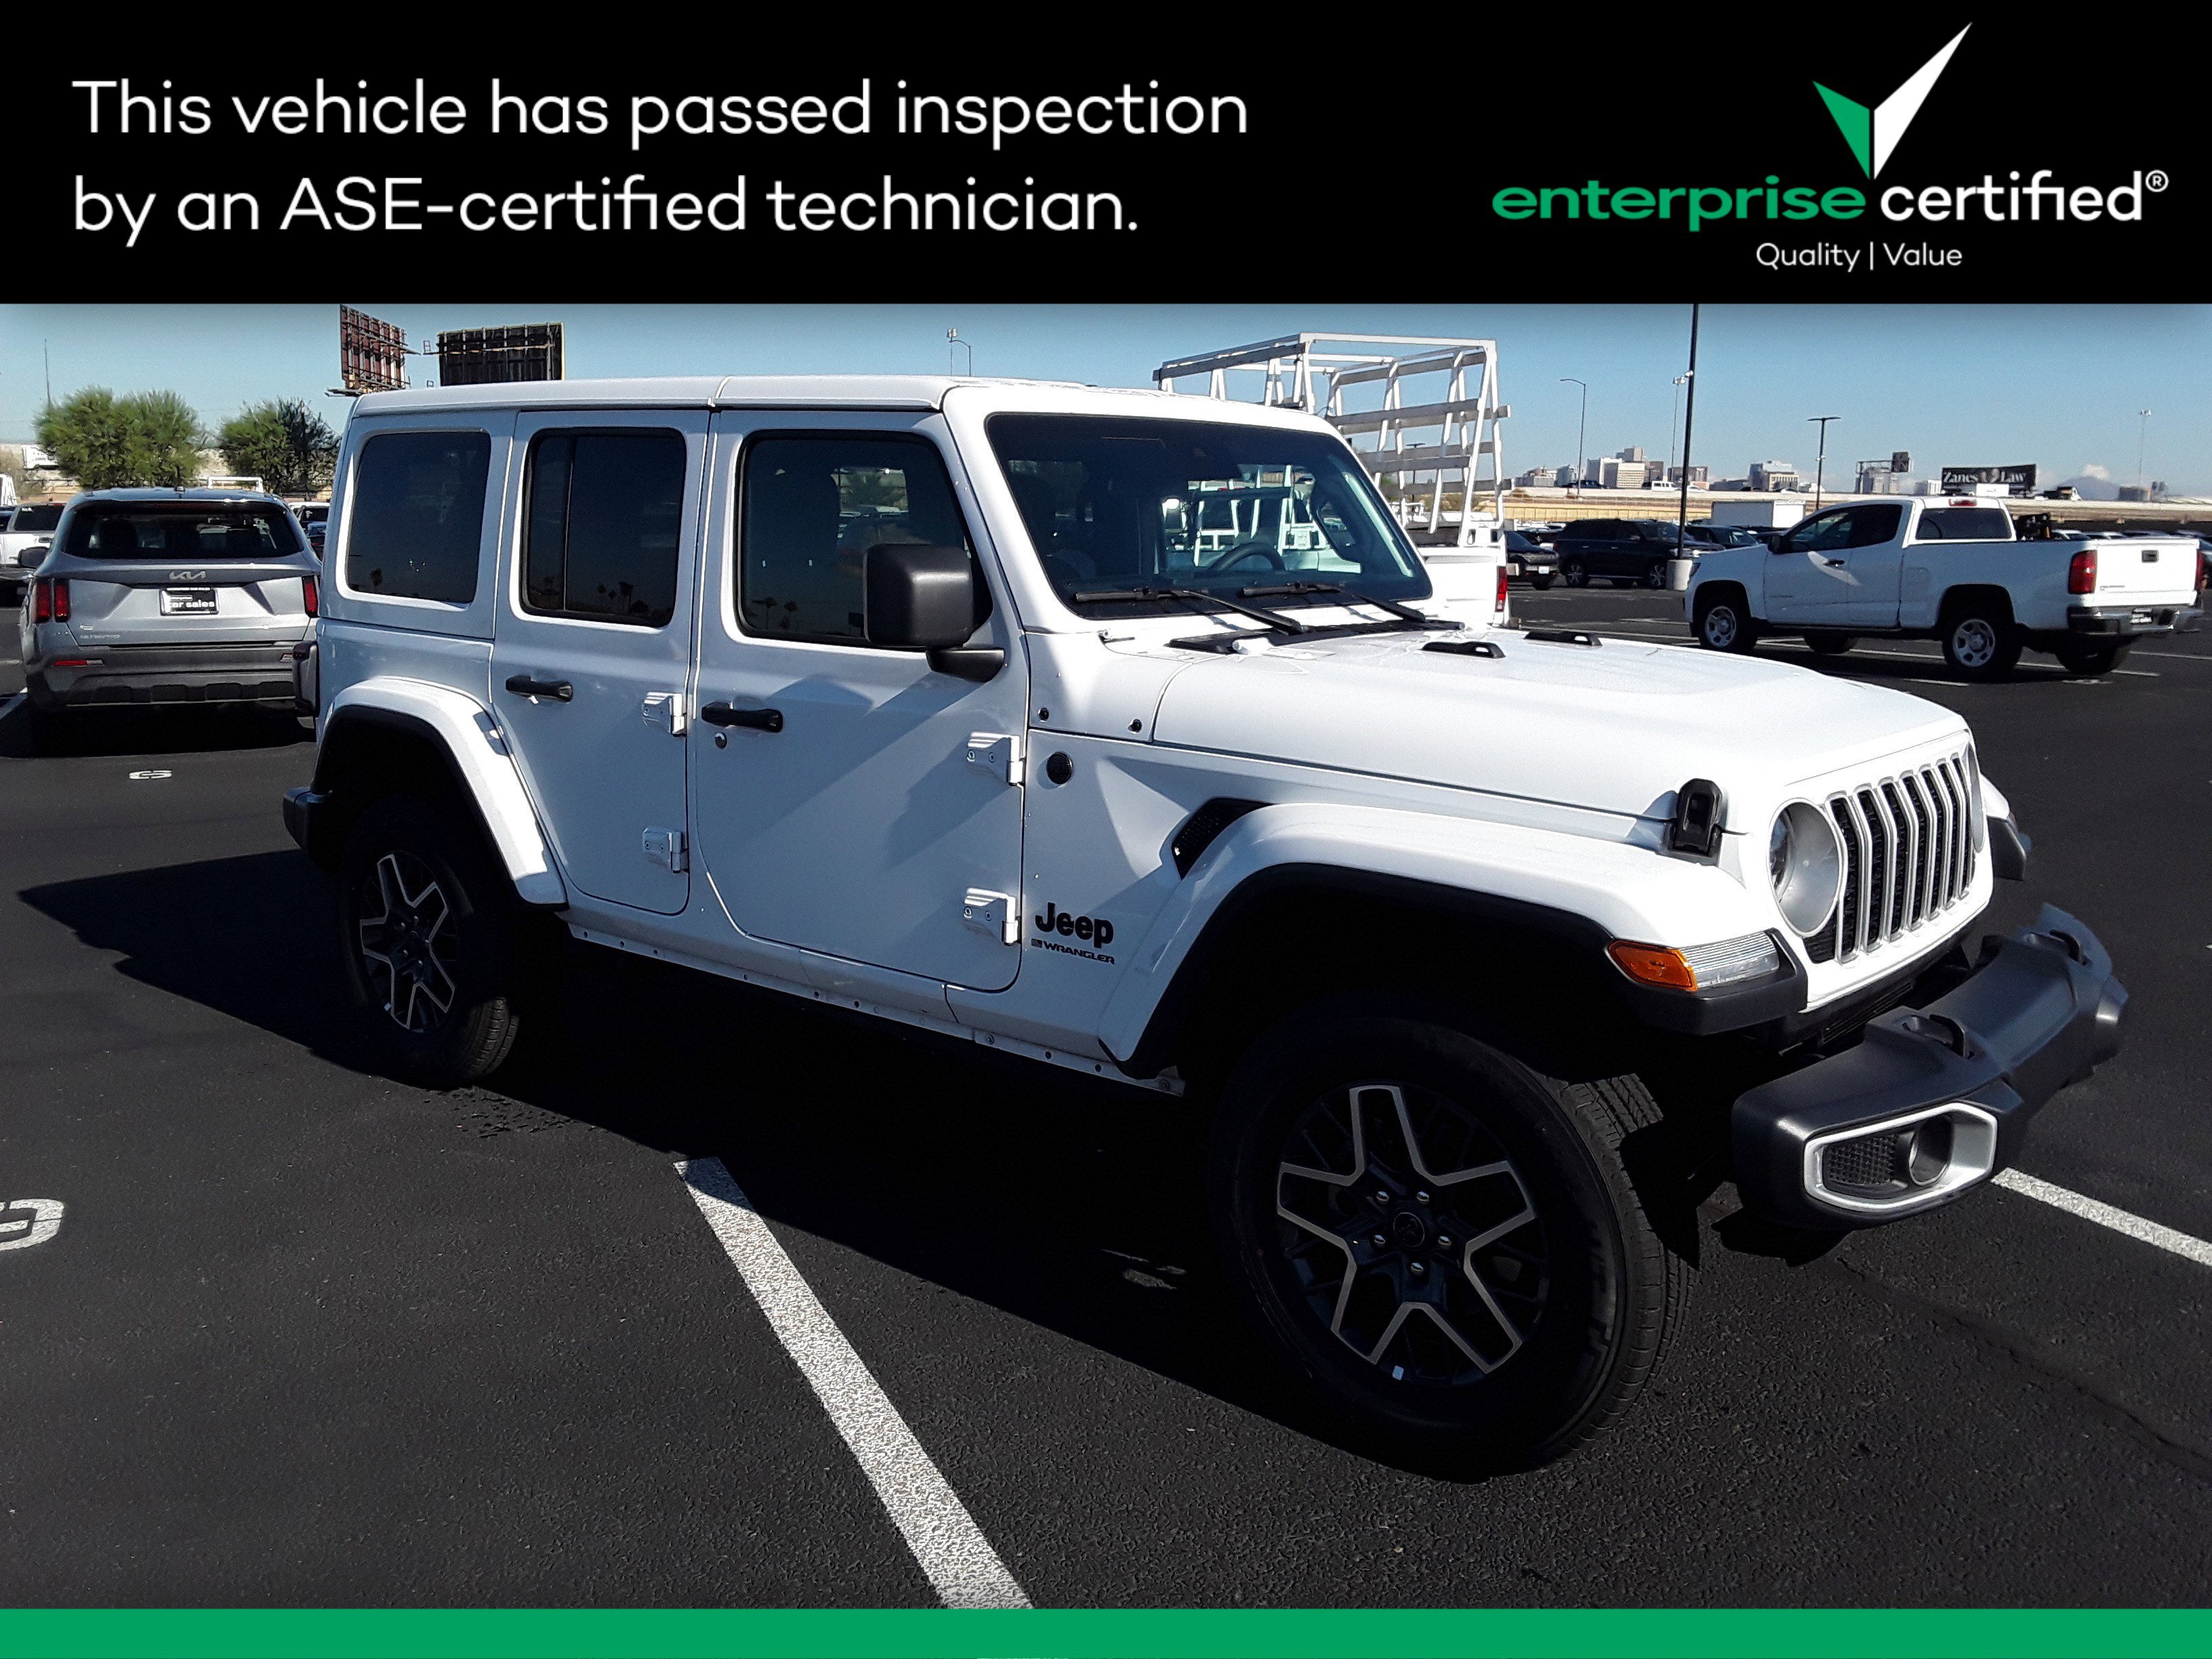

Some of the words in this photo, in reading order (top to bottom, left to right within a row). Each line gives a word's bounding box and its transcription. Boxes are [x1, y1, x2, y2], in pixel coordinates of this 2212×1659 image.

[186, 599, 215, 608] sales
[1035, 902, 1114, 949] Jeep
[1043, 941, 1115, 965] WRANGLER
